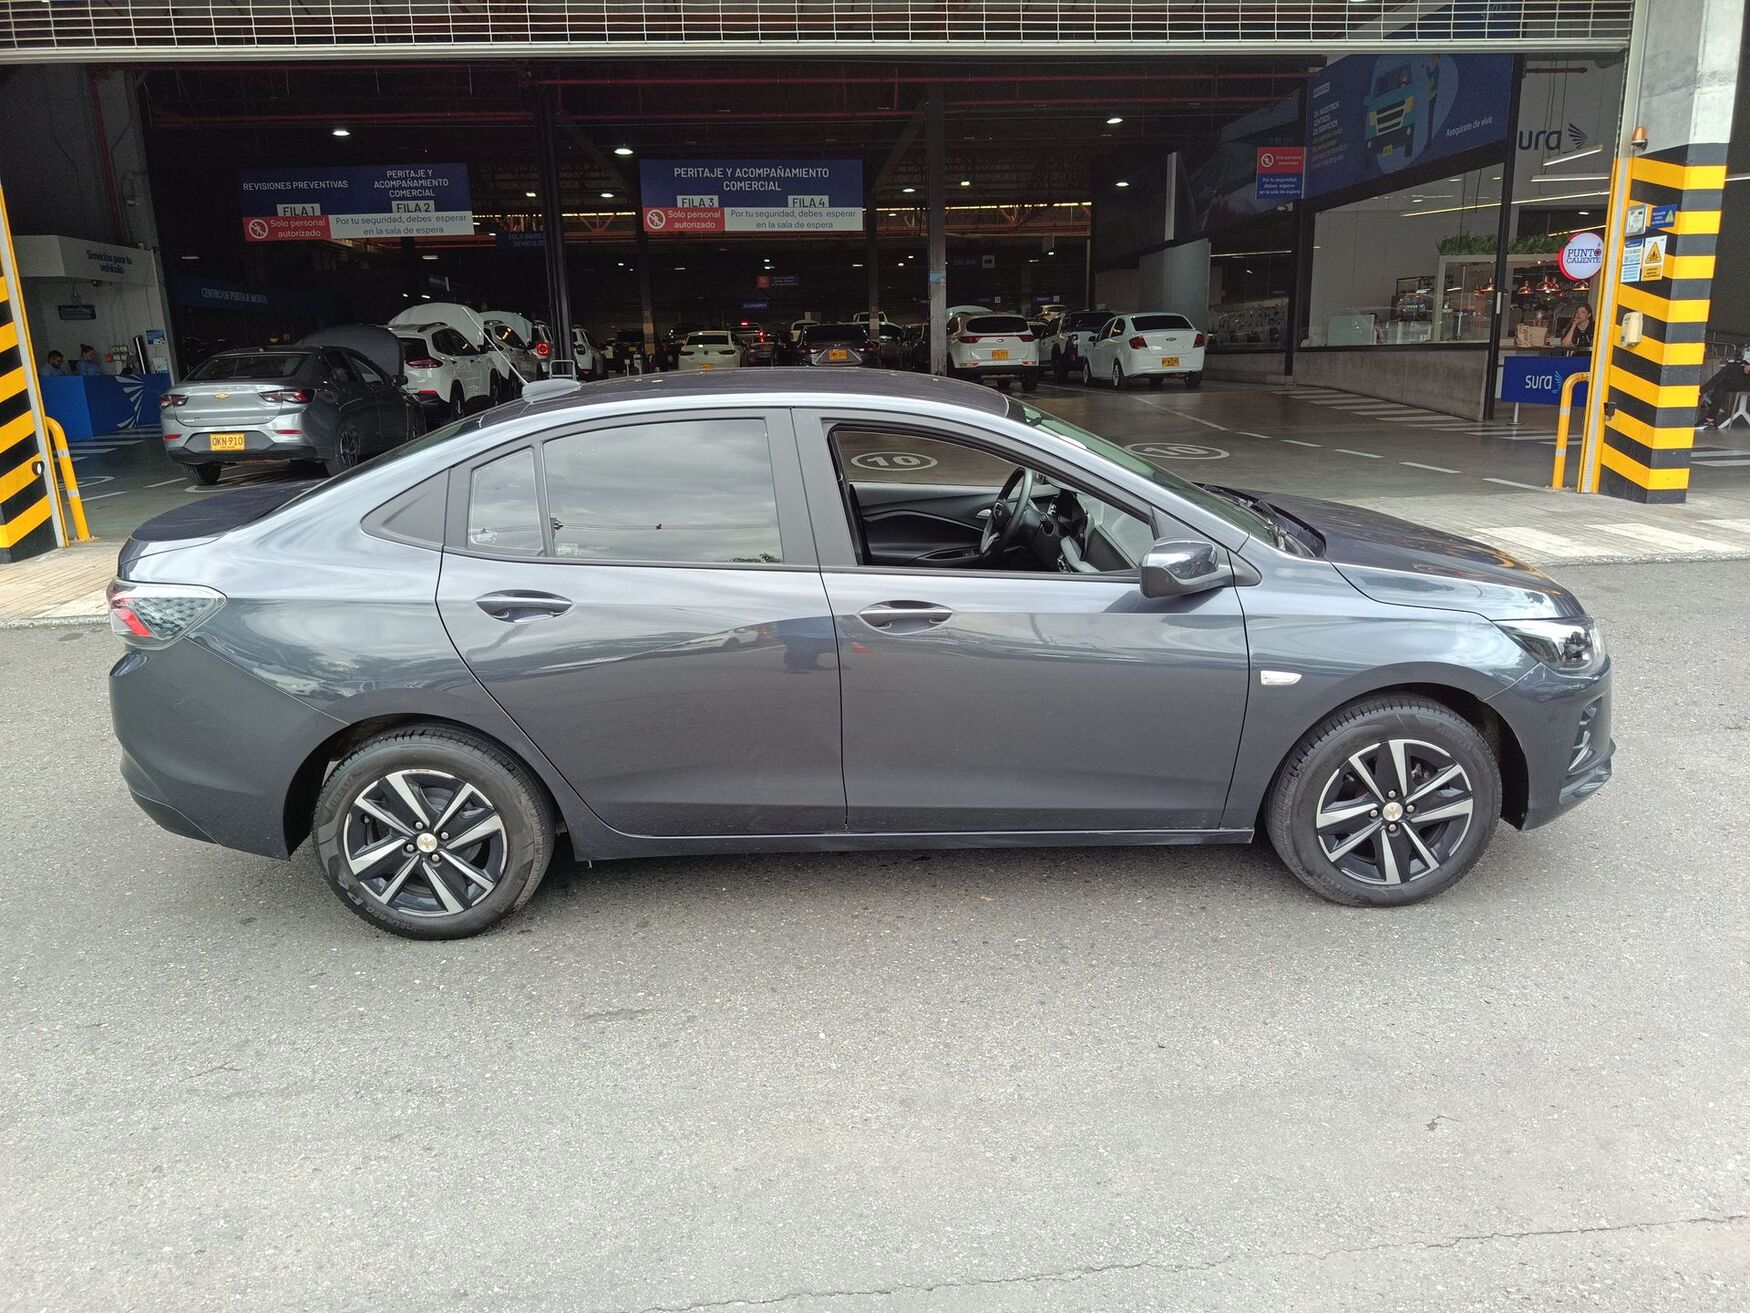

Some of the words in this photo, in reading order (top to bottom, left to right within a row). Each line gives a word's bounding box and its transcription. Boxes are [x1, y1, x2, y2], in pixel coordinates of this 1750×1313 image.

[1518, 130, 1562, 151] ura
[387, 169, 426, 178] PERITAJE
[427, 169, 433, 177] Y
[674, 168, 724, 178] PERITAJE
[725, 168, 733, 178] Y
[734, 166, 830, 178] ACOMPAÑAMIENTO
[243, 181, 292, 191] REVISIONES
[292, 180, 349, 189] PREVENTIVAS
[373, 178, 449, 189] ACOMPAÑAMIENTO
[723, 181, 782, 191] COMERCIAL
[389, 189, 436, 198] COMERCIAL
[396, 203, 421, 213] FILA
[423, 203, 430, 213] 2
[681, 198, 706, 208] FILA
[708, 198, 714, 208] 3
[792, 198, 817, 208] FILA
[818, 198, 826, 208] 4
[283, 206, 309, 216] FILA
[310, 206, 316, 216] 1
[668, 210, 686, 219] Solo
[687, 210, 721, 220] personal
[730, 210, 744, 218] Por
[745, 210, 753, 218] tu
[754, 209, 797, 220] seguridad,
[798, 209, 823, 218] debes
[826, 210, 856, 220] esperar
[270, 219, 289, 228] Solo
[290, 218, 326, 228] personal
[335, 217, 350, 225] Por
[351, 217, 360, 225] tu
[360, 215, 405, 226] seguridad,
[406, 215, 432, 223] debes
[435, 215, 467, 224] esperar
[674, 221, 716, 229] autorizado
[768, 221, 775, 229] la
[776, 221, 793, 229] sala
[794, 221, 805, 229] de
[806, 222, 833, 230] espera
[278, 229, 321, 238] autorizado
[385, 227, 401, 235] sala
[402, 227, 414, 235] de
[415, 227, 444, 236] espera
[87, 250, 113, 262] Servicios
[113, 255, 125, 264] para
[1567, 248, 1602, 258] PUNTO
[1525, 375, 1552, 389] sura
[1143, 446, 1209, 456] 10
[866, 456, 921, 466] 10
